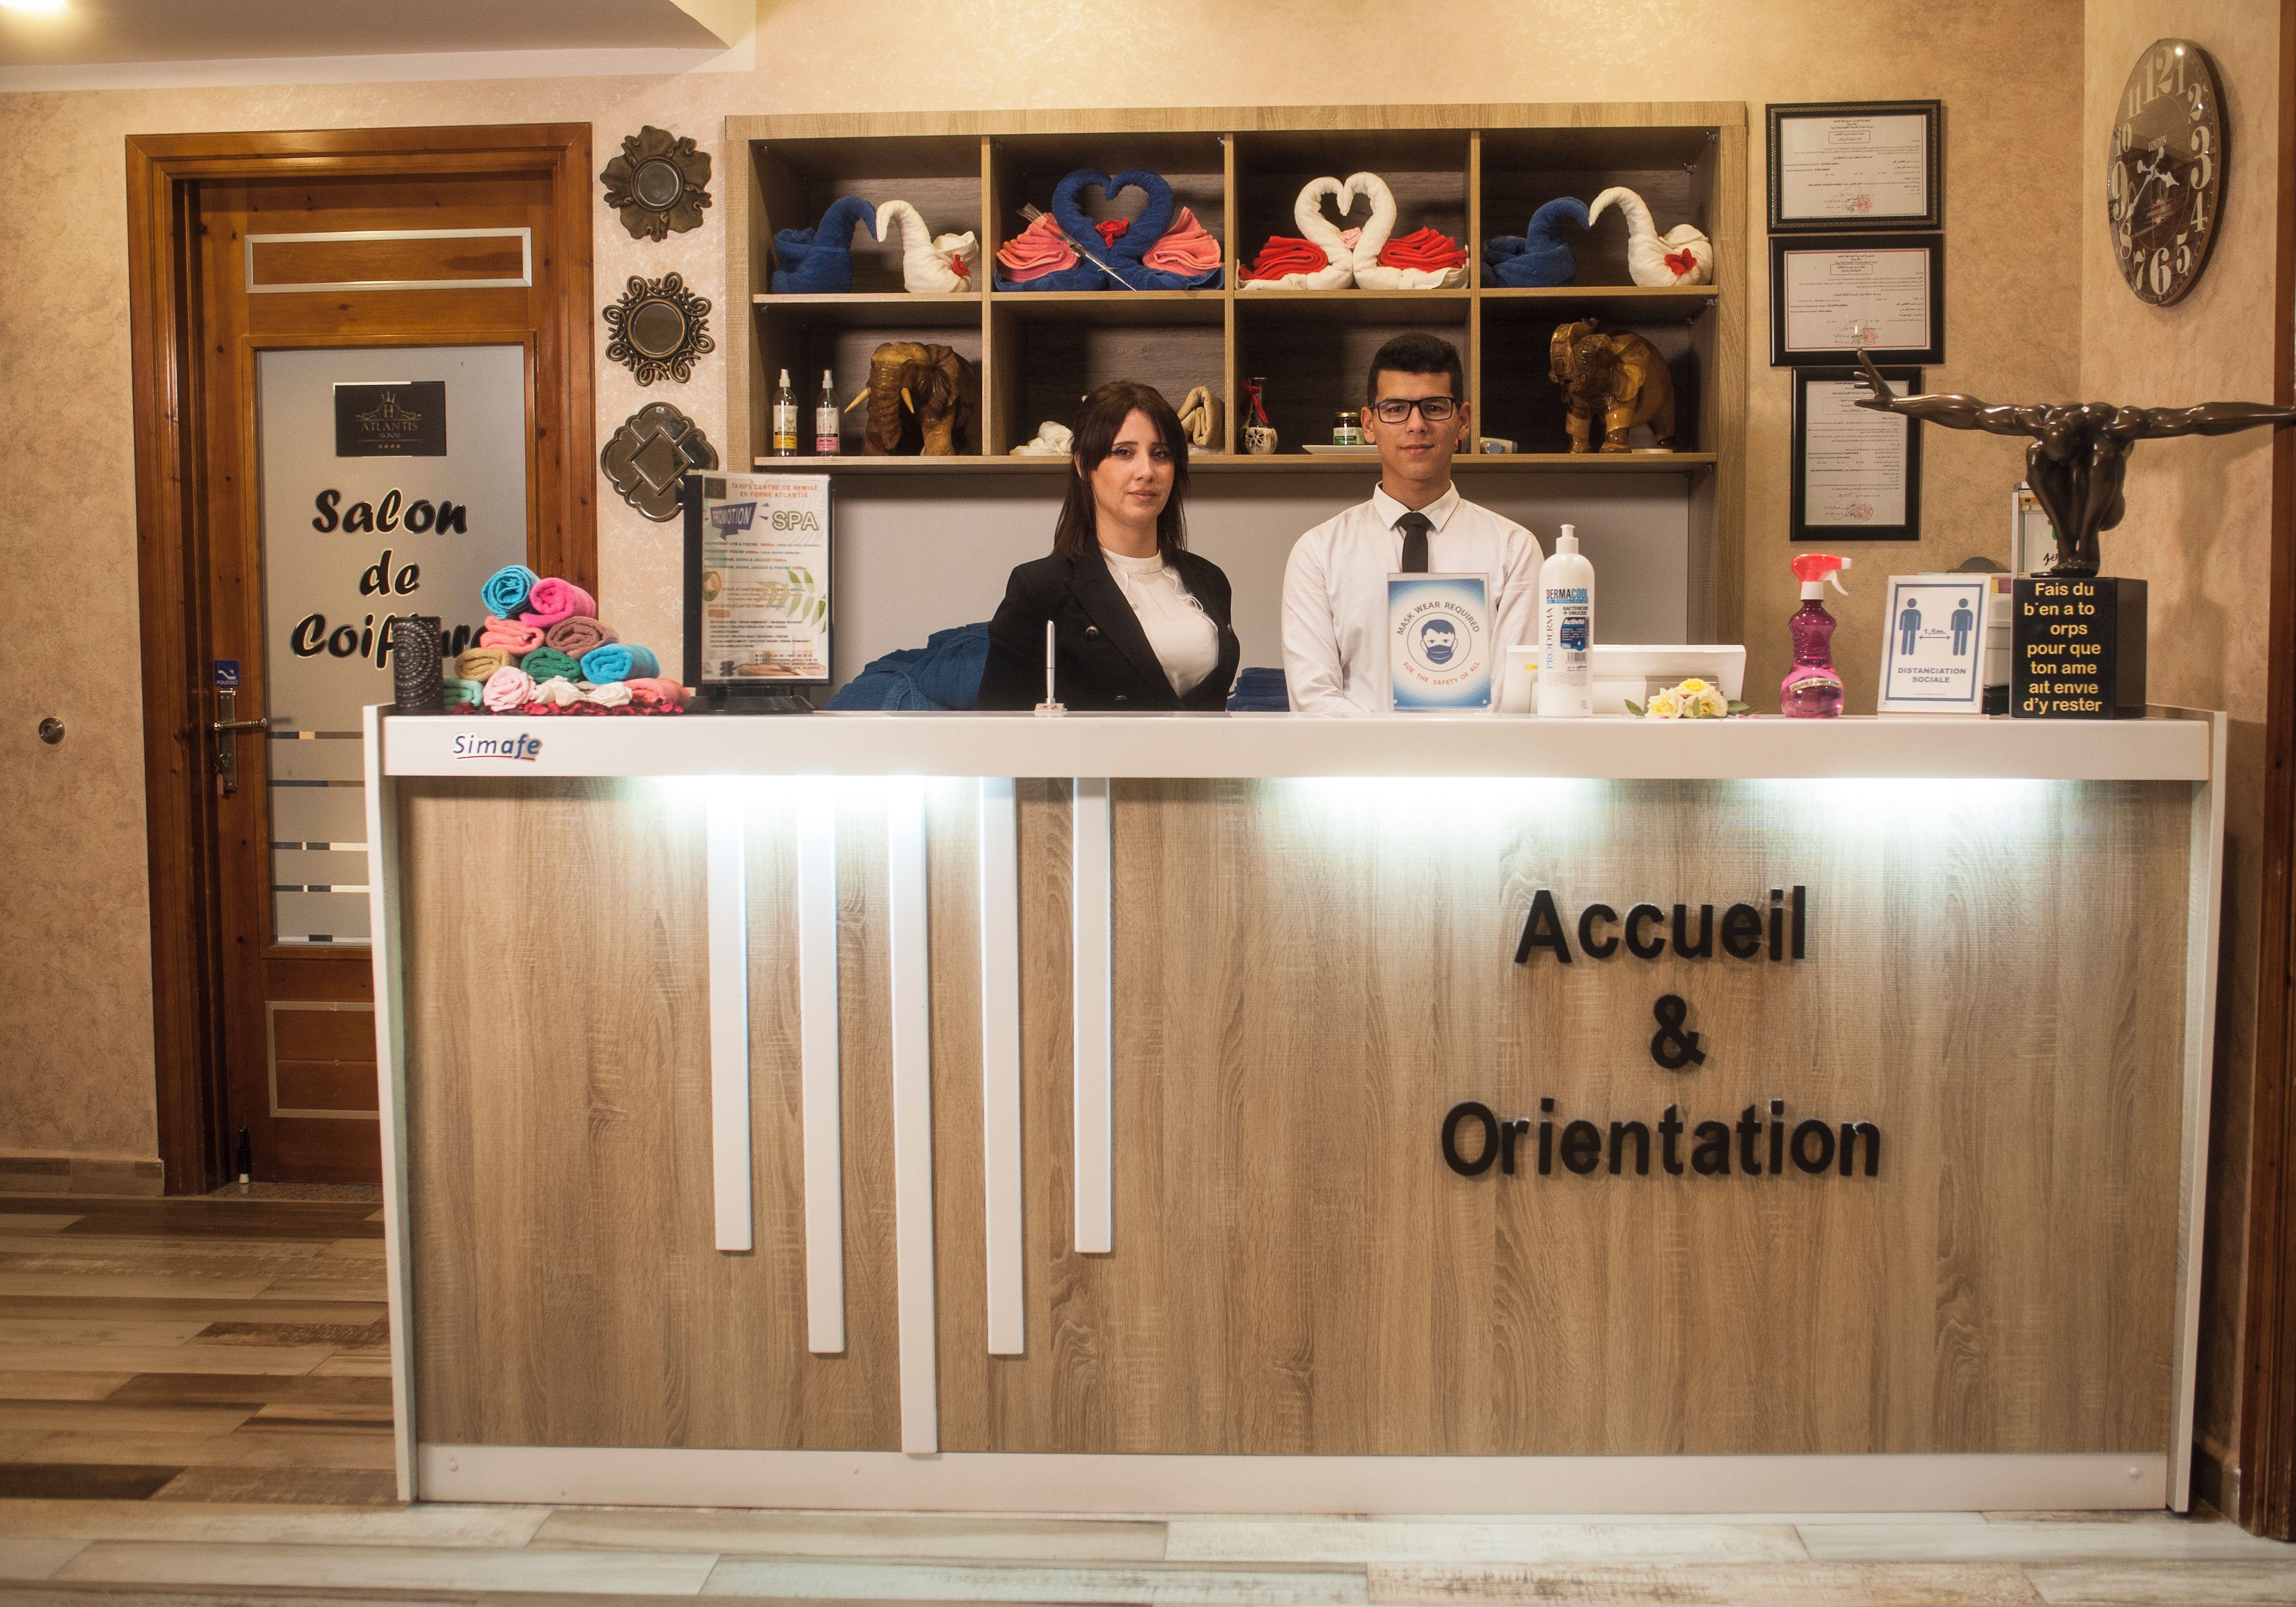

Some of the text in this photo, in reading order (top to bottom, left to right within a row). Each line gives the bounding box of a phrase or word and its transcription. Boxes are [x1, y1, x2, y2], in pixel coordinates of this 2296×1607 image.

[2143, 46, 2173, 104] 12
[2127, 82, 2142, 120] 11
[2187, 83, 2202, 125] 2
[2191, 126, 2212, 189] 3
[2111, 161, 2128, 221] 9
[2191, 192, 2208, 232] 4
[2119, 222, 2133, 259] 8
[2176, 231, 2191, 274] 5
[2133, 249, 2146, 290] 7
[2149, 247, 2171, 295] 6
[361, 422, 418, 432] ATLANTIS
[311, 488, 467, 535] Salon
[713, 507, 752, 525] PROMOTION
[773, 511, 818, 531] SPA
[359, 549, 419, 597] de
[2035, 582, 2094, 596] Fais du
[1546, 589, 1588, 599] DERMACOOL
[2064, 606, 2074, 615] a
[2078, 603, 2095, 615] to
[1397, 601, 1480, 635] MASK WEAR REQUIRED
[2050, 624, 2088, 638] orps
[2027, 644, 2101, 658] pour que
[2031, 661, 2097, 674] ton ame
[1416, 673, 1429, 682] THE
[1470, 661, 1480, 673] ALL
[2029, 680, 2098, 694] ait envie
[2053, 698, 2103, 712] rester
[453, 734, 541, 759] Simafe
[1515, 885, 1806, 964] Accueil
[1650, 994, 1706, 1069] &
[1441, 1097, 1880, 1176] Orientation
